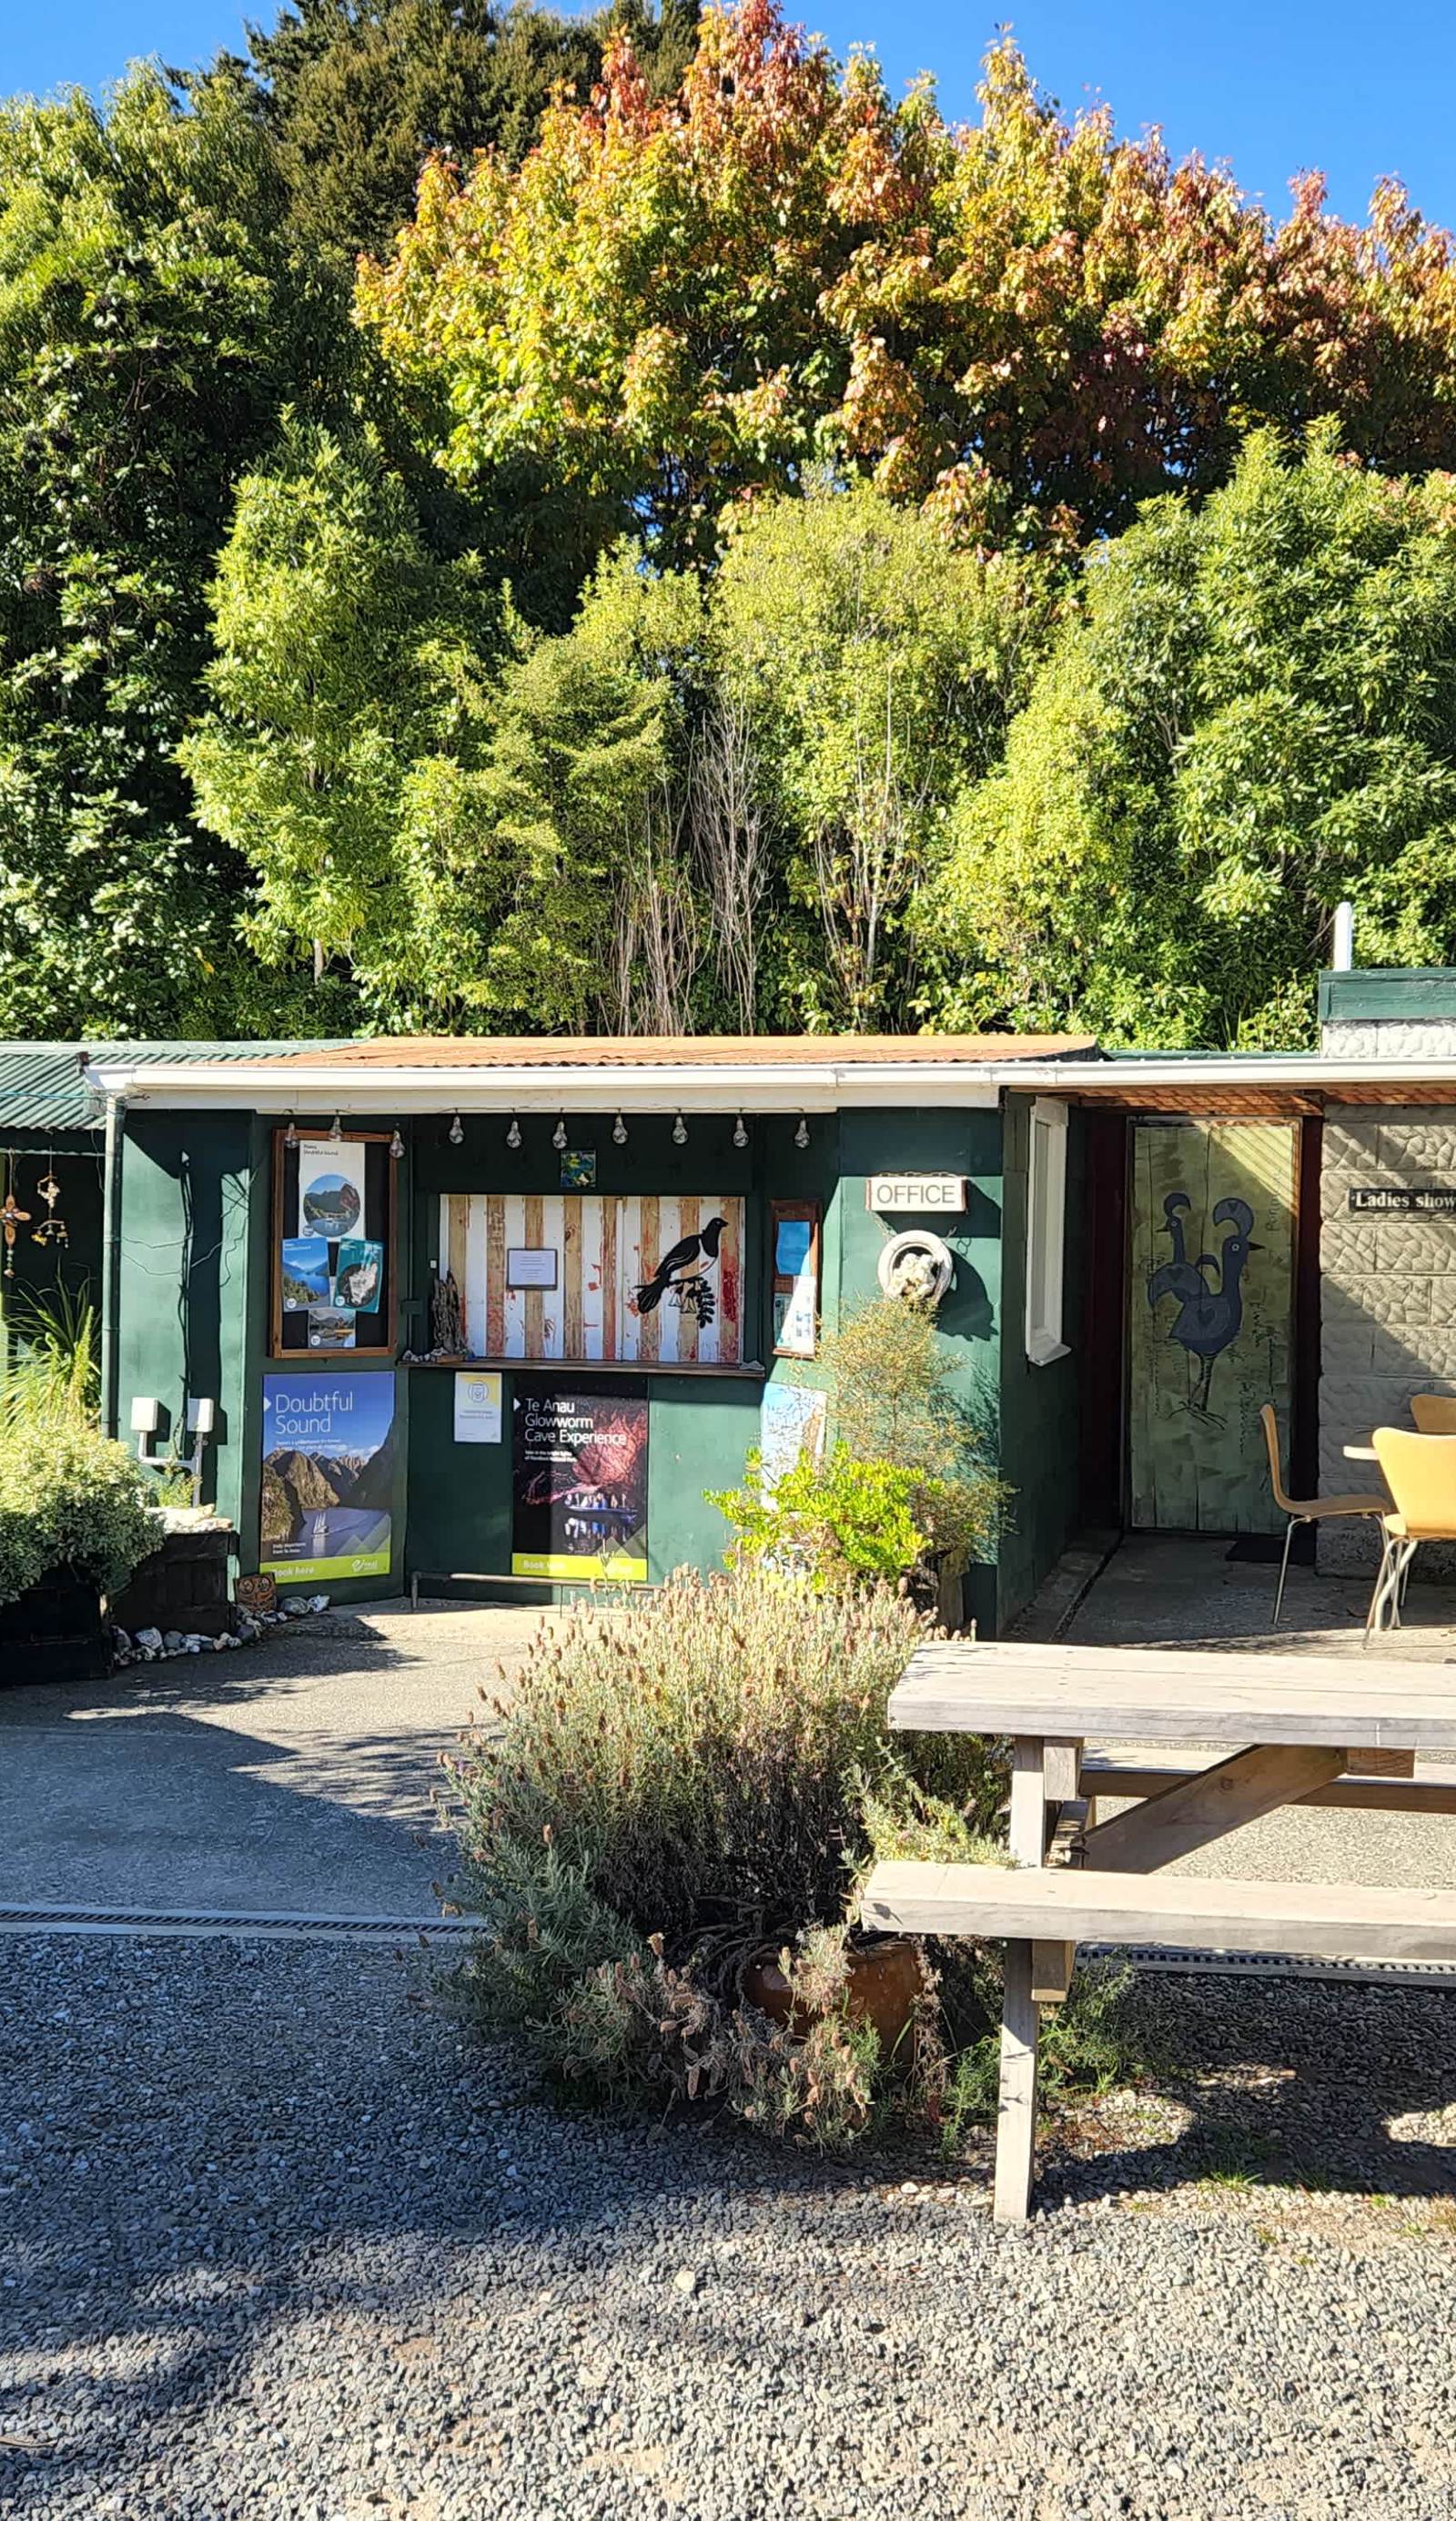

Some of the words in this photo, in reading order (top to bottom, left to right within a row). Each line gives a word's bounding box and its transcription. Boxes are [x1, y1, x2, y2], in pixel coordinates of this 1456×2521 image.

[876, 1184, 956, 1205] OFFICE
[1355, 1191, 1410, 1209] Ladies
[276, 1391, 354, 1413] Doubtful
[524, 1397, 541, 1412] Te
[542, 1398, 575, 1413] Anau
[276, 1412, 331, 1434] Sound
[524, 1412, 594, 1429] Glowworm
[524, 1428, 557, 1443] Cave
[559, 1429, 628, 1447] Experience
